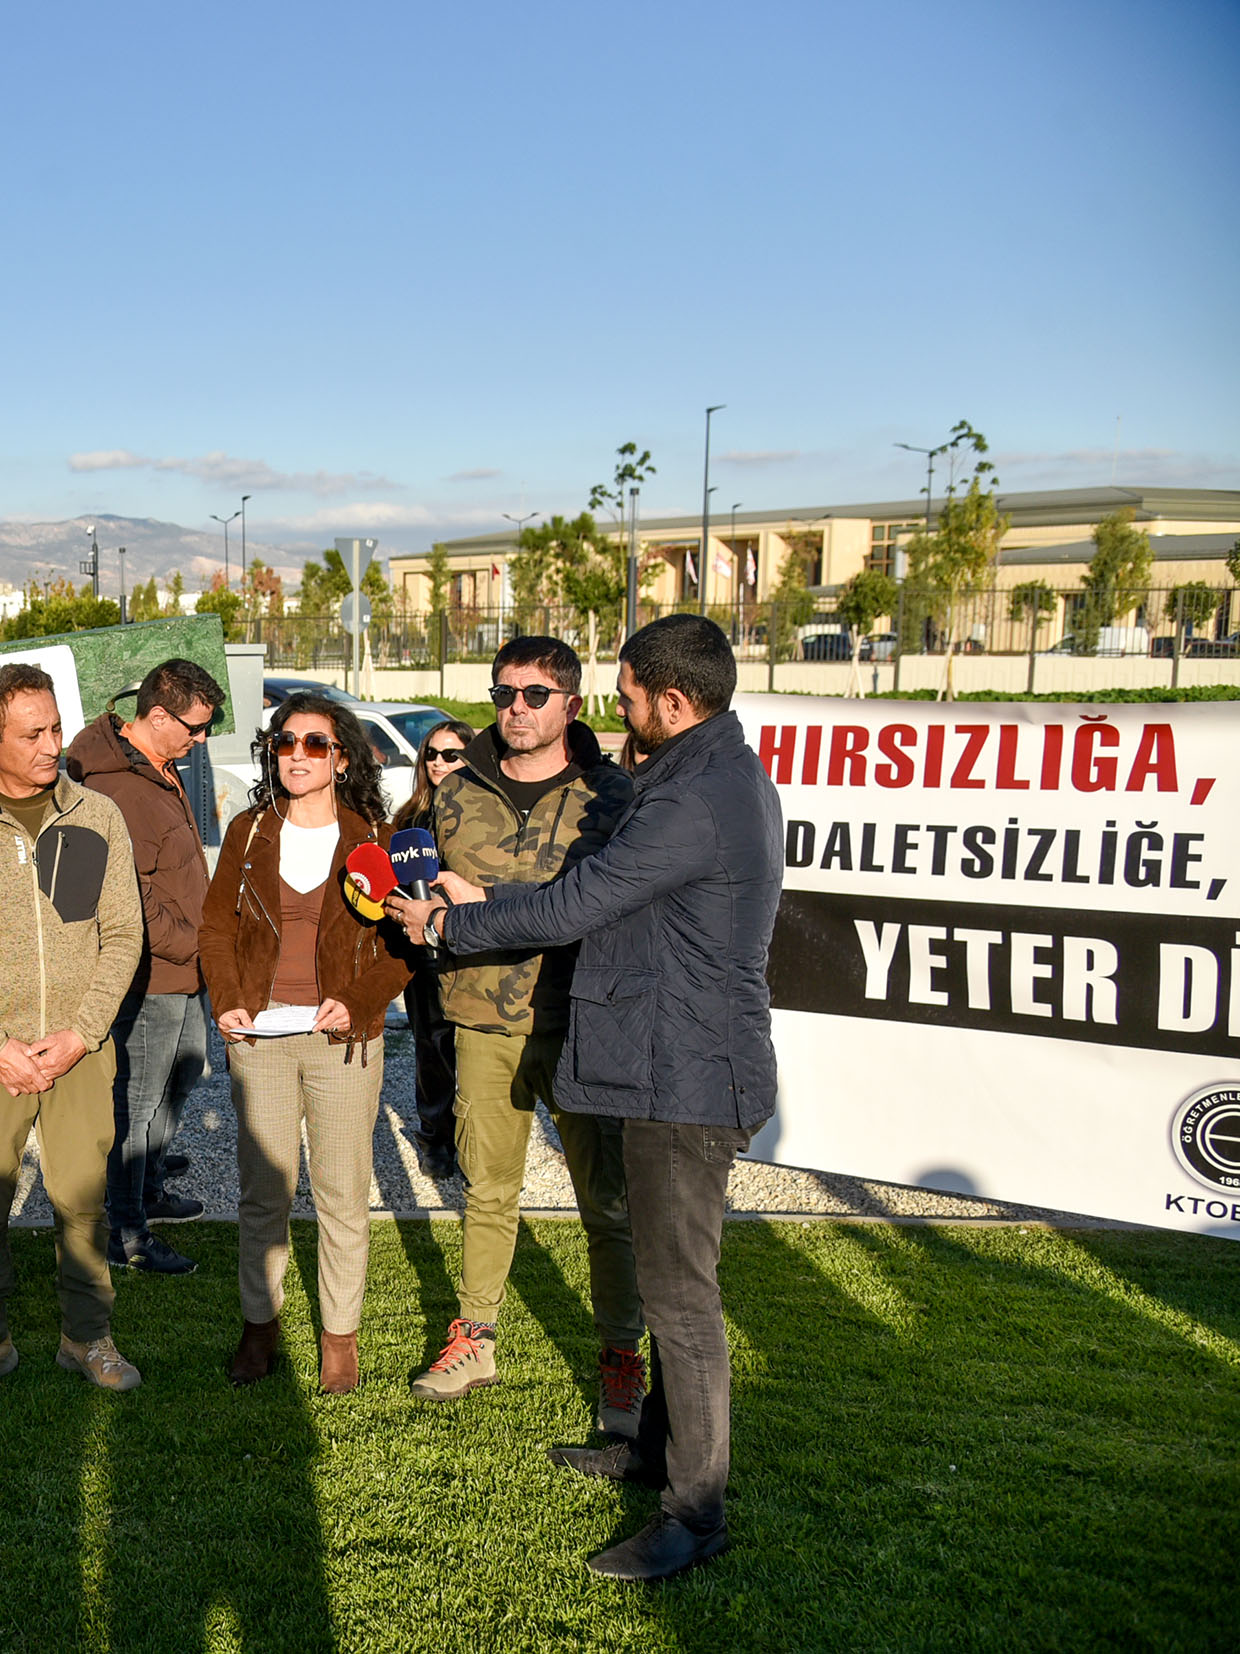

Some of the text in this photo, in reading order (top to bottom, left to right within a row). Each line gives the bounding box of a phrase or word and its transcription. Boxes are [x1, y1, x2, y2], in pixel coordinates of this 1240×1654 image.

[759, 714, 1217, 806] HIRSIZLIĞA,
[391, 846, 420, 863] myk
[785, 817, 1227, 901] DALETSİZLİĞE,
[854, 919, 1118, 1025] YETER
